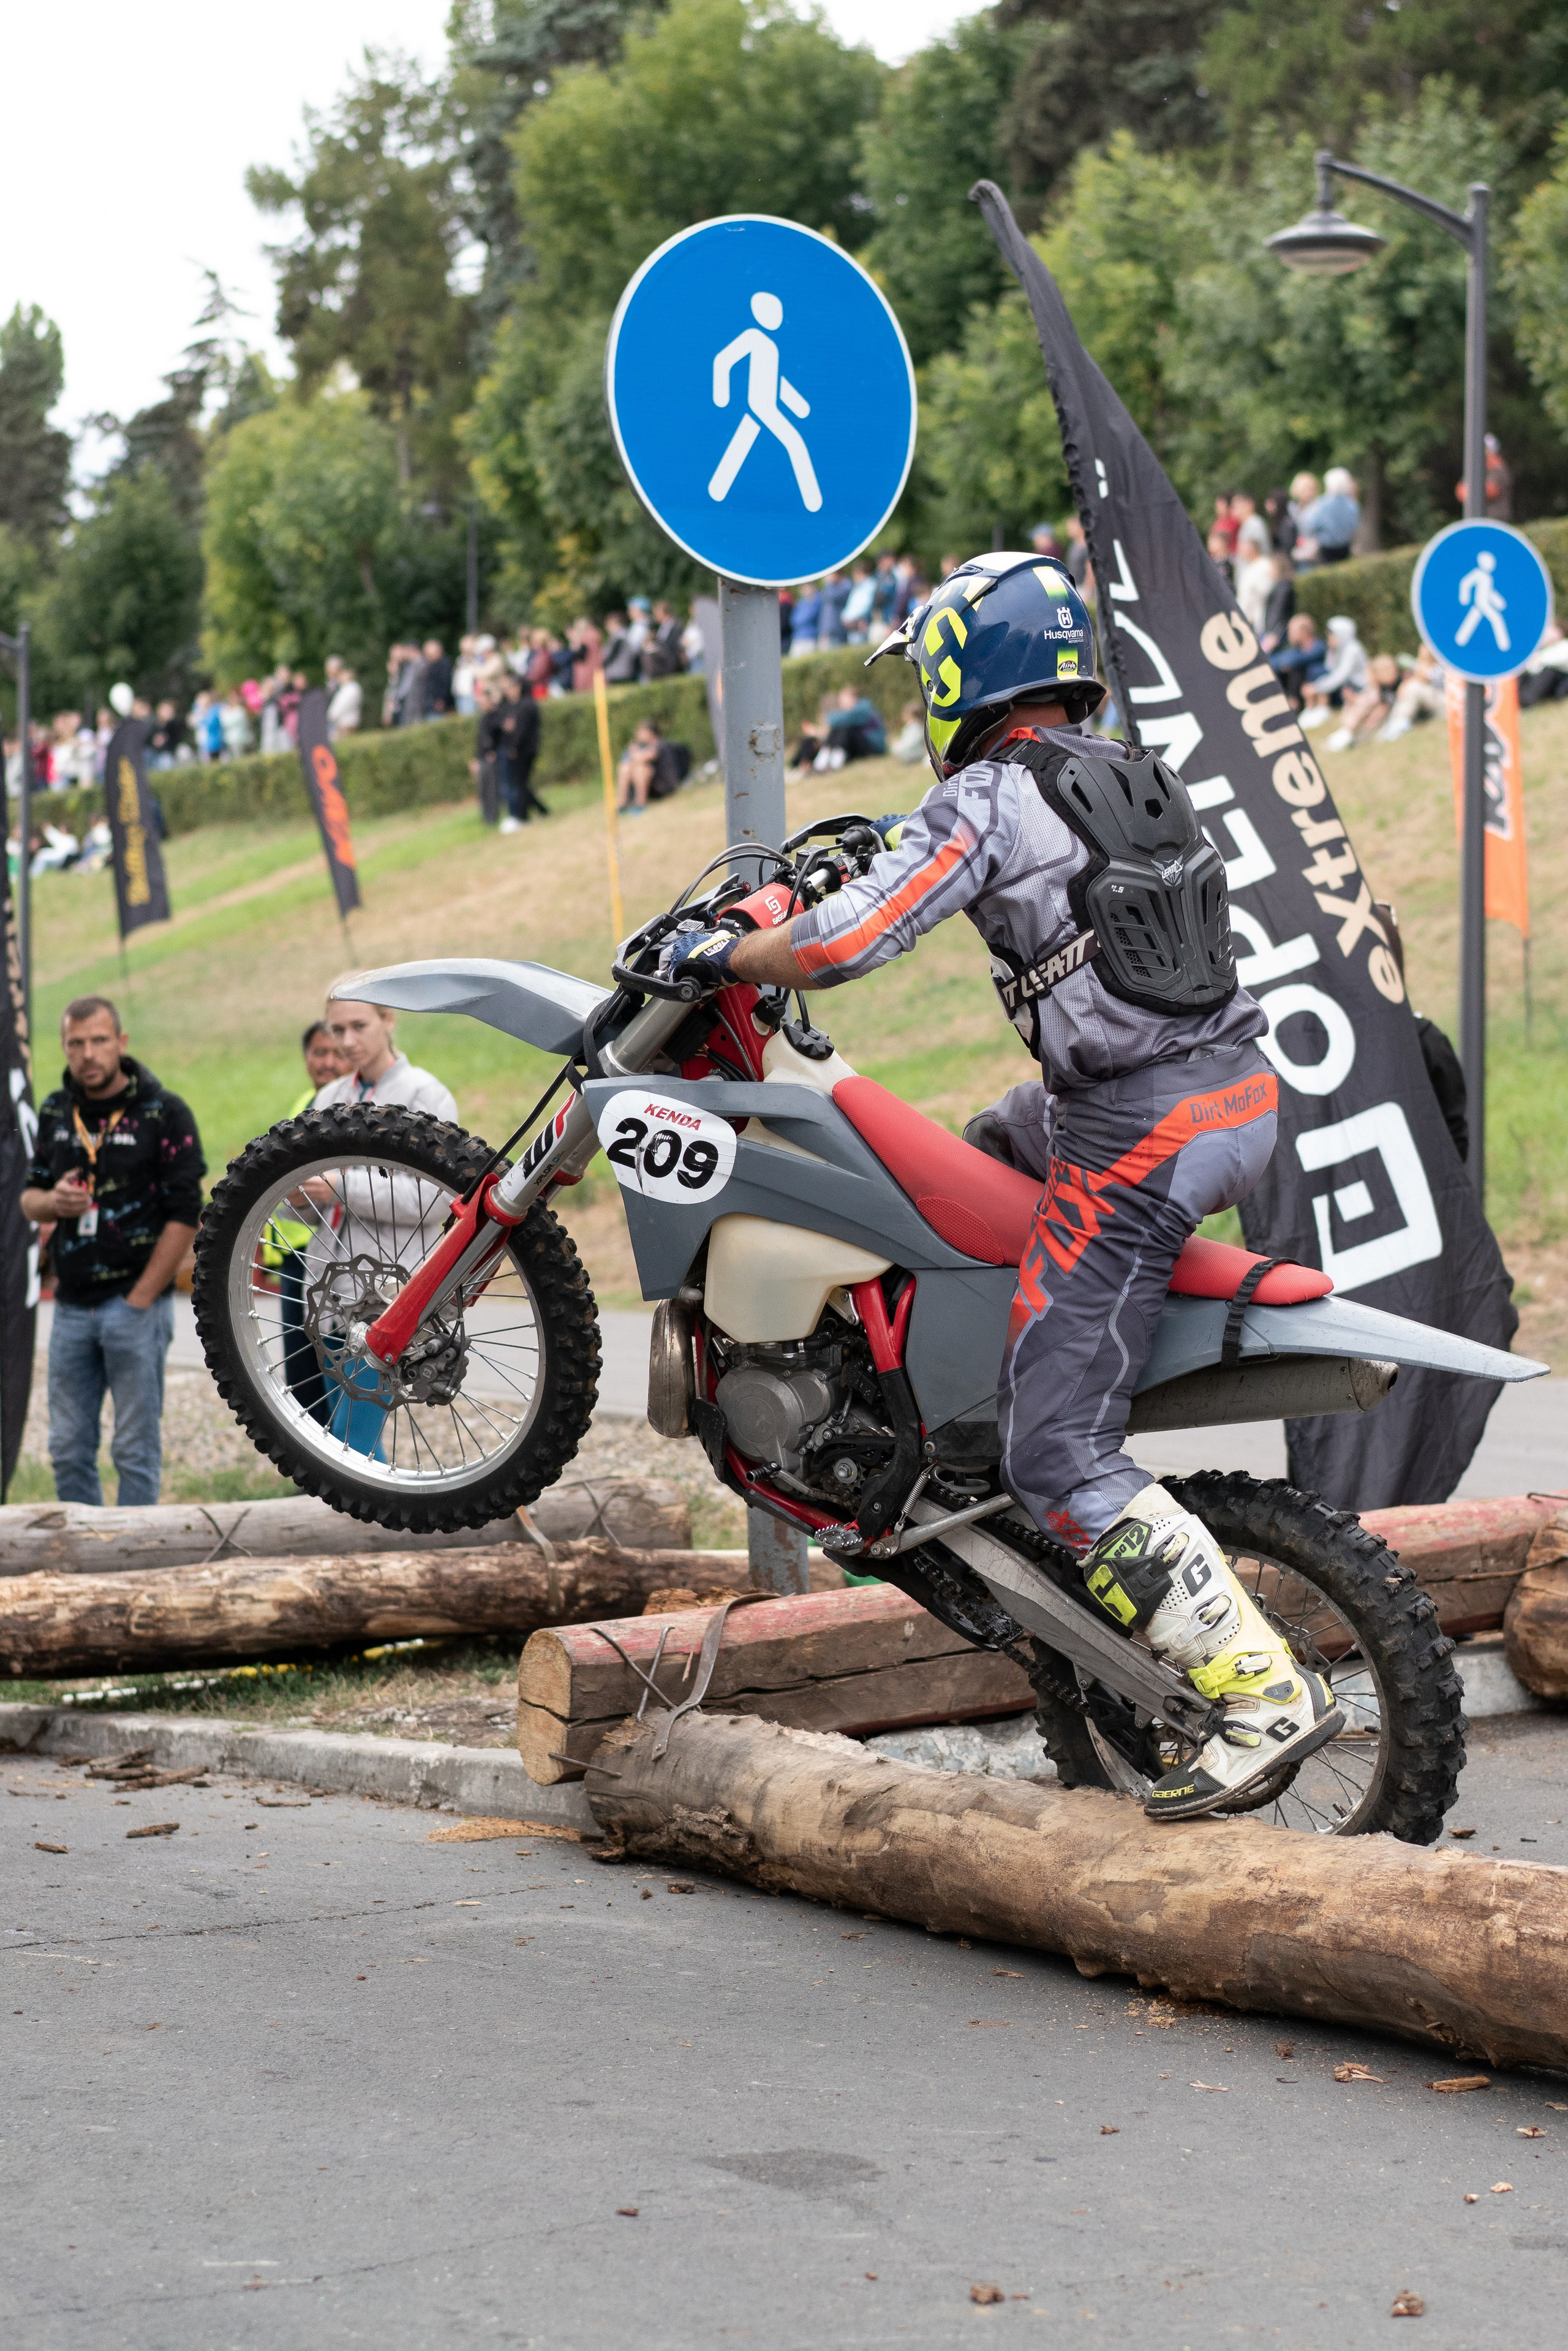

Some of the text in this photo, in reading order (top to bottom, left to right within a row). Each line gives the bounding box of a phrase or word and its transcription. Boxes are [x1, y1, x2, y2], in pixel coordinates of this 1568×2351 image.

[1044, 629, 1084, 640] Husqvarna
[1058, 662, 1077, 671] Airoh
[772, 909, 788, 926] GASGA
[643, 1103, 702, 1131] KENDA
[1189, 1100, 1223, 1124] Dirt
[606, 1117, 719, 1190] 209
